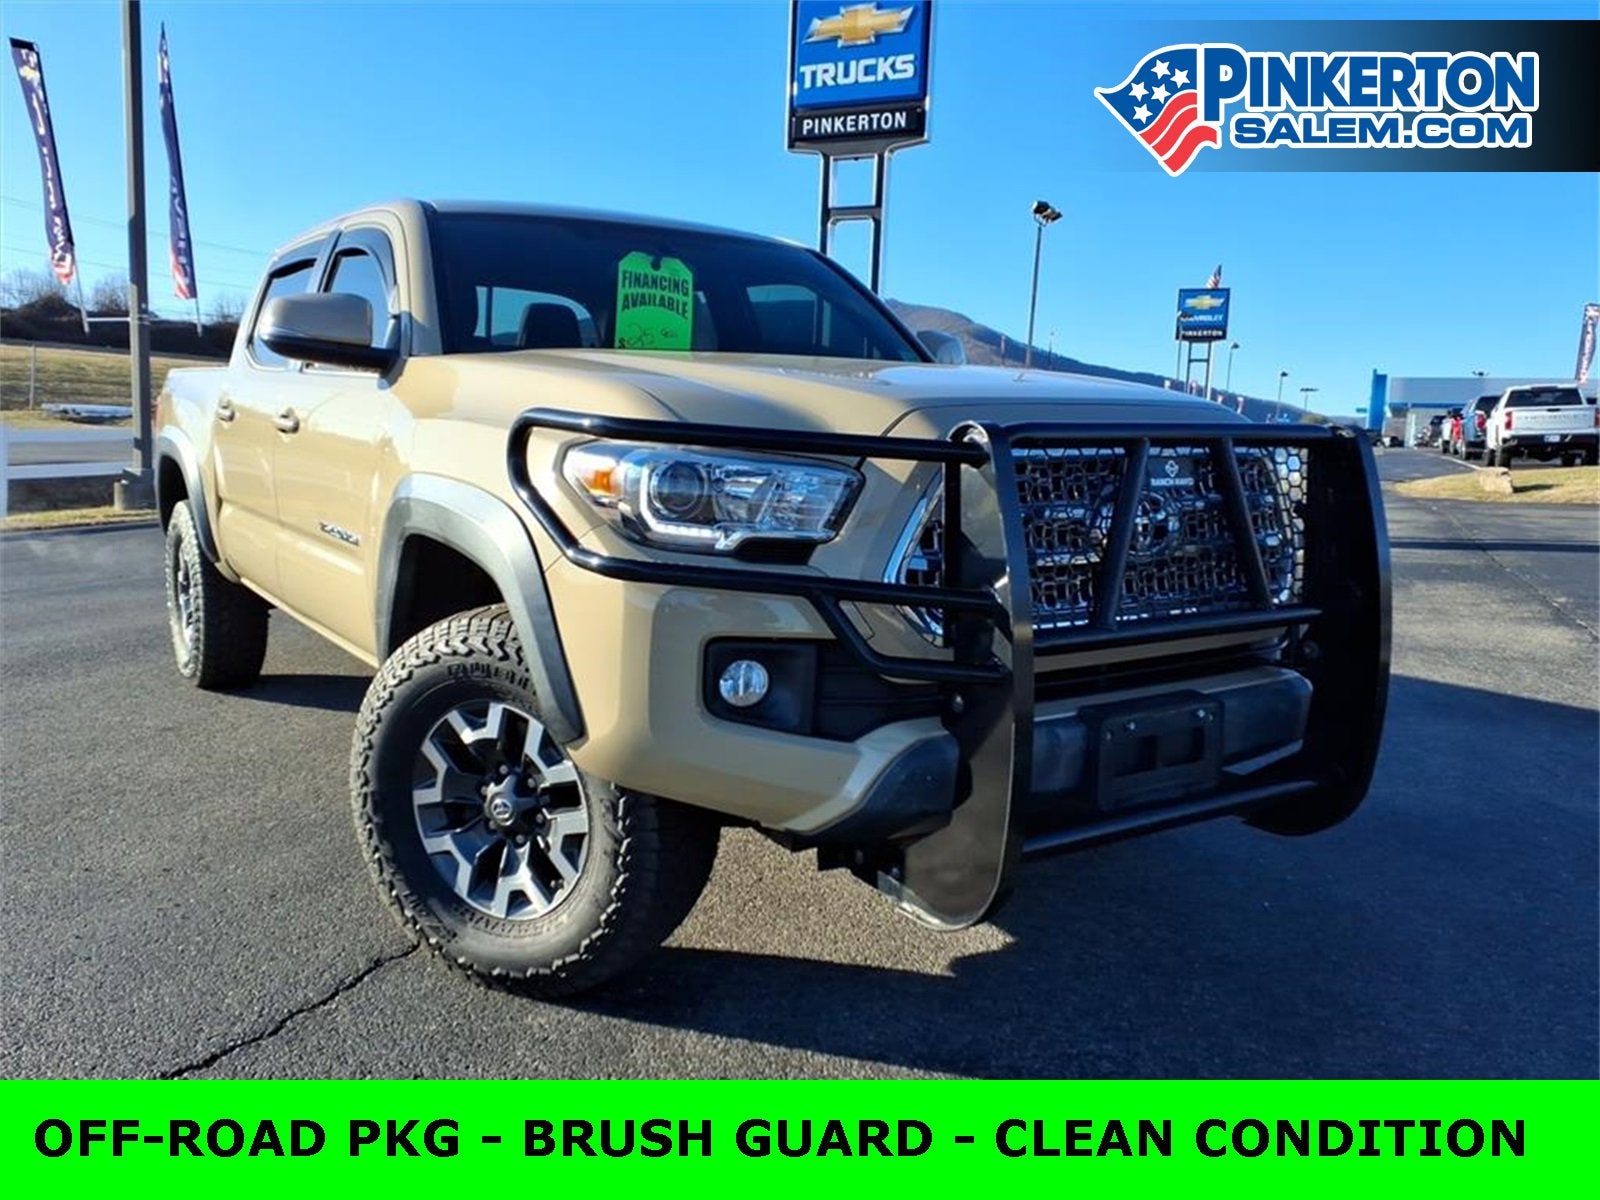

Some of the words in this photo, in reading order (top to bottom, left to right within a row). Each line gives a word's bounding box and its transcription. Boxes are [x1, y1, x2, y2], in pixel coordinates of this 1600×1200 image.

[799, 53, 916, 90] TRUCKS
[802, 111, 907, 135] PINKERTON
[622, 270, 689, 297] FINANCING
[622, 292, 689, 321] AVAILABLE
